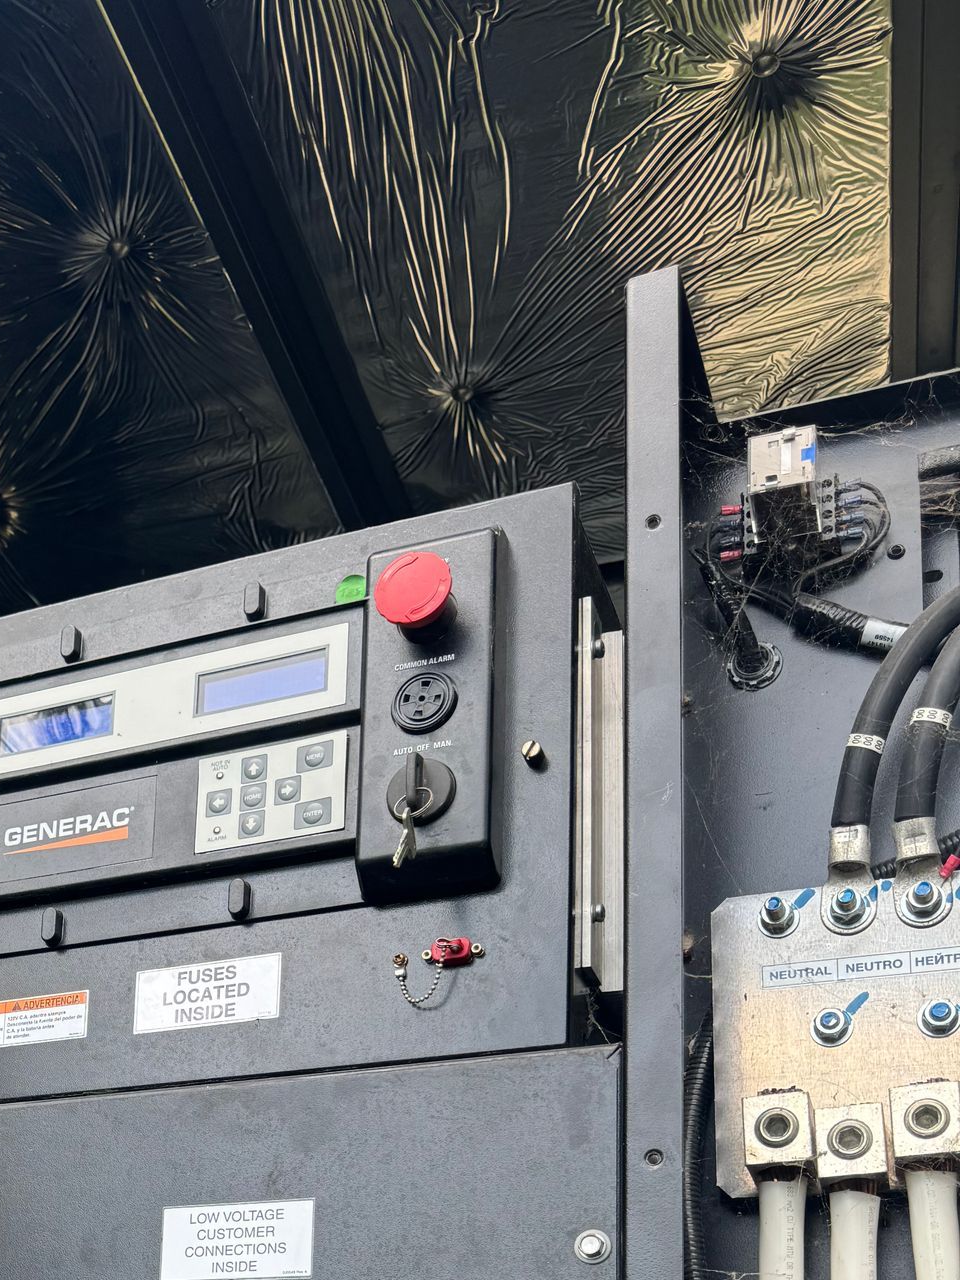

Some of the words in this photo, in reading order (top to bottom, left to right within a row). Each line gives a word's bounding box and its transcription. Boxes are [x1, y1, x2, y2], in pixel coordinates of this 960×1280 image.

[394, 660, 427, 672] COMMON
[428, 654, 455, 665] ALARM
[393, 746, 412, 756] AUTO
[416, 743, 430, 752] OFF
[304, 810, 322, 818] ENTER
[4, 807, 130, 847] GENERAC
[846, 959, 903, 974] NEUTRO
[915, 952, 960, 968] НЕЙТР
[177, 966, 237, 986] FUSES
[769, 966, 832, 981] NEUTRAL
[162, 982, 250, 1006] LOCATED
[24, 995, 79, 1010] ADVERTENCIA
[174, 1002, 236, 1023] INSIDE
[189, 1212, 220, 1225] LOW
[222, 1208, 285, 1222] VOLTAGE
[196, 1226, 276, 1241] CUSTOMER
[184, 1242, 287, 1258] CONNECTIONS
[211, 1261, 258, 1274] INSIDE
